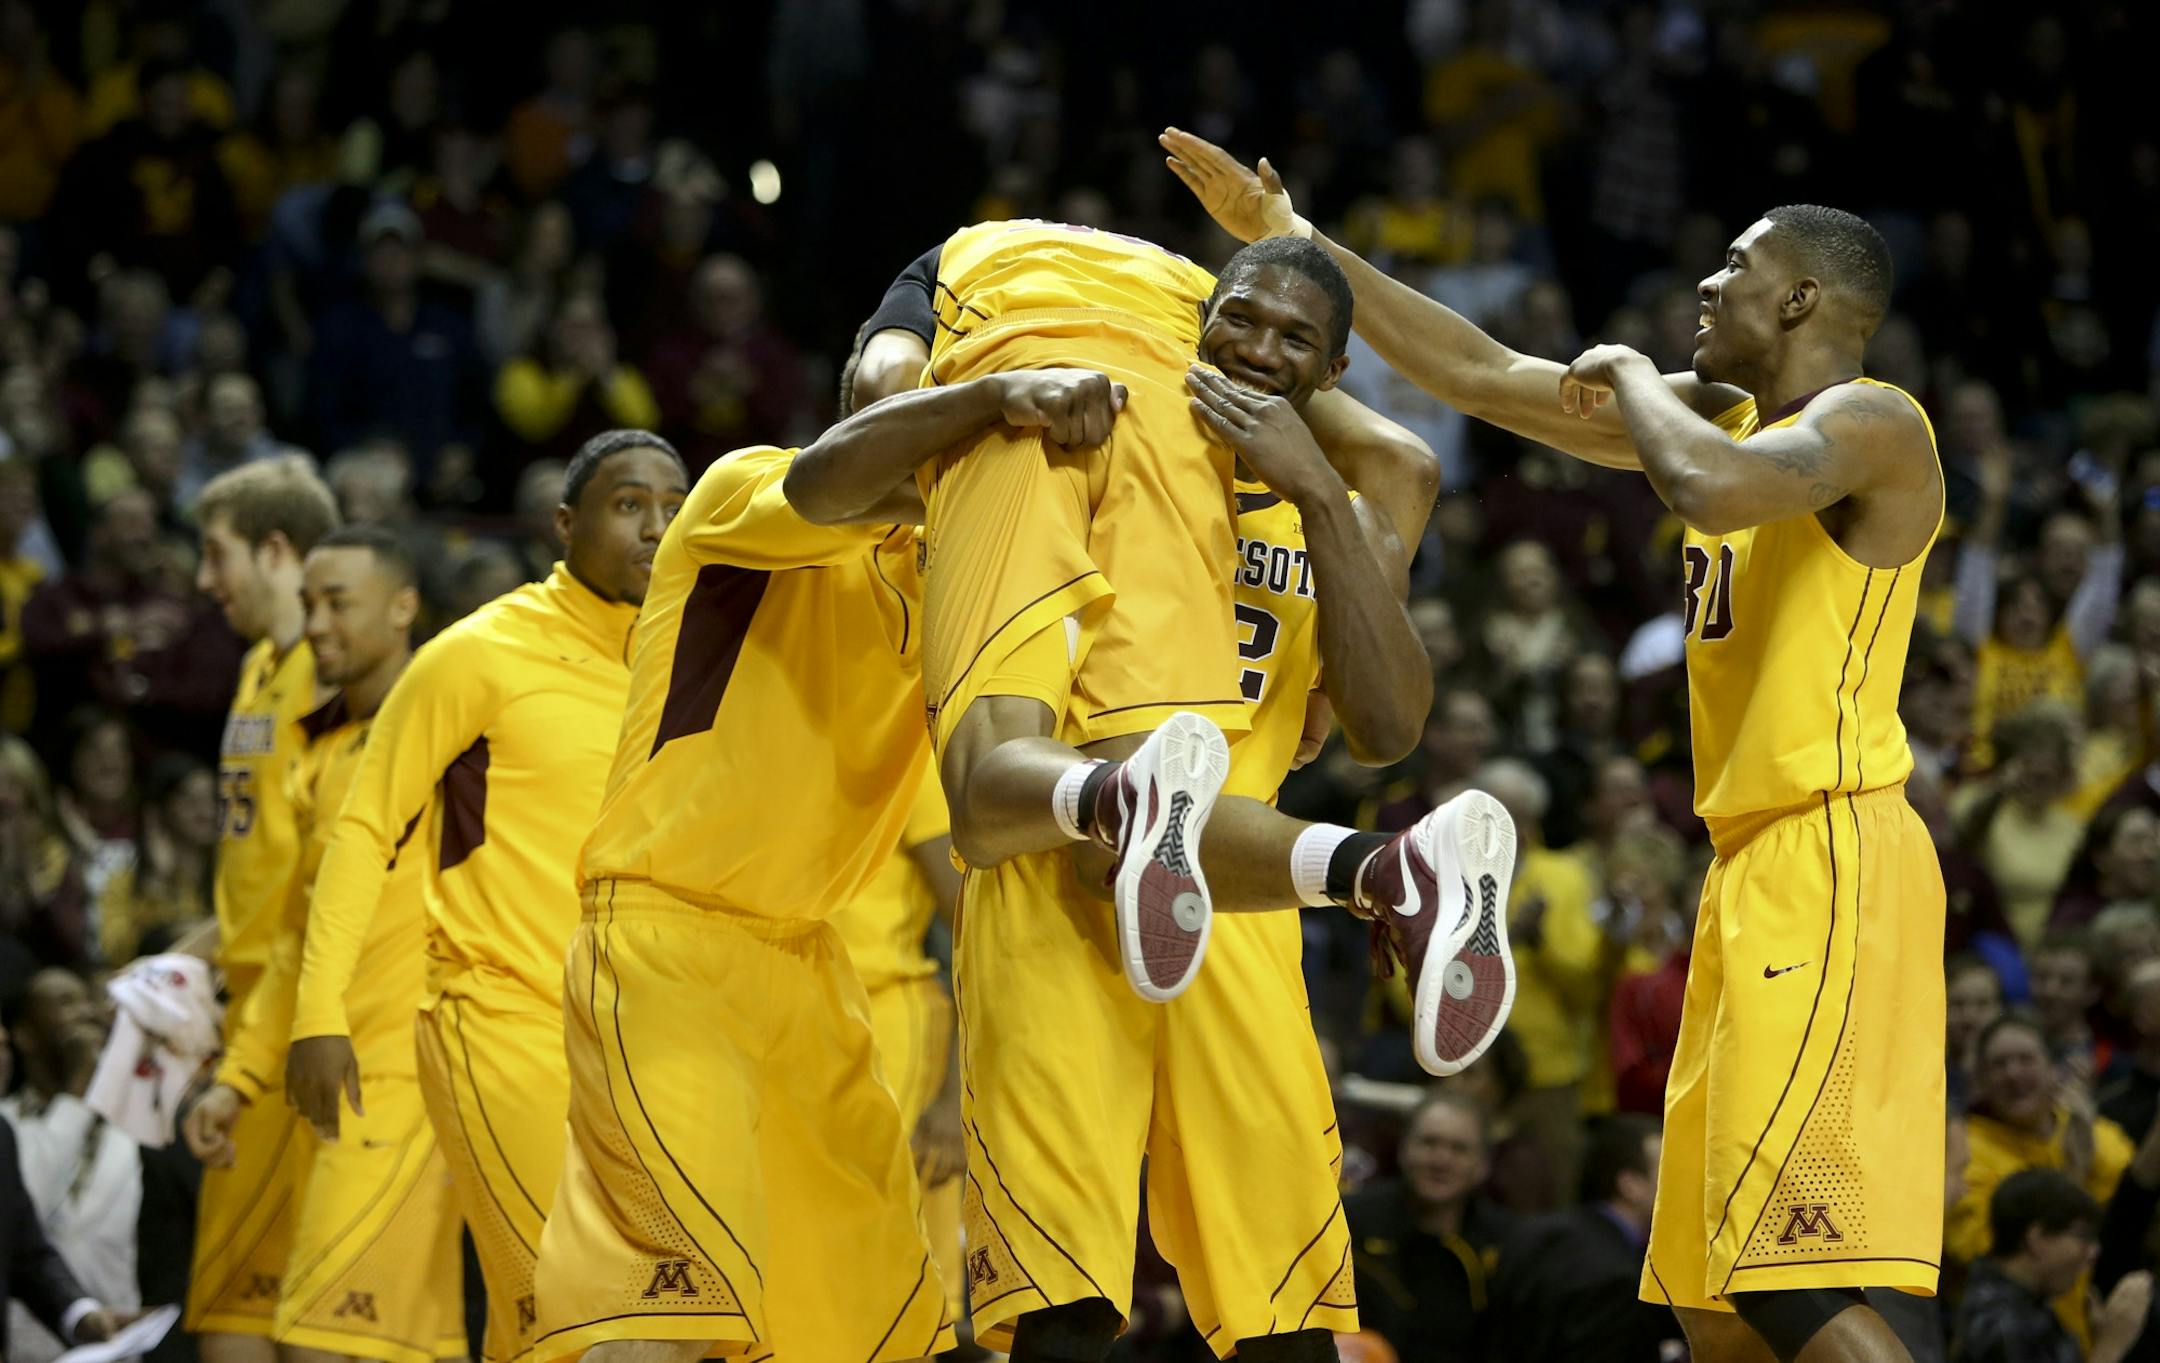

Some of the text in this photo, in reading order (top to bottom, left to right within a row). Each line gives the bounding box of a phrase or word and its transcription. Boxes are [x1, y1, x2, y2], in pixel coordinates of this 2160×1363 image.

[1234, 536, 1317, 602] SOT
[1685, 543, 1735, 642] 30
[1235, 603, 1280, 703] 2
[1777, 1203, 1843, 1245] M
[333, 1289, 379, 1323] M
[641, 1259, 699, 1299] M
